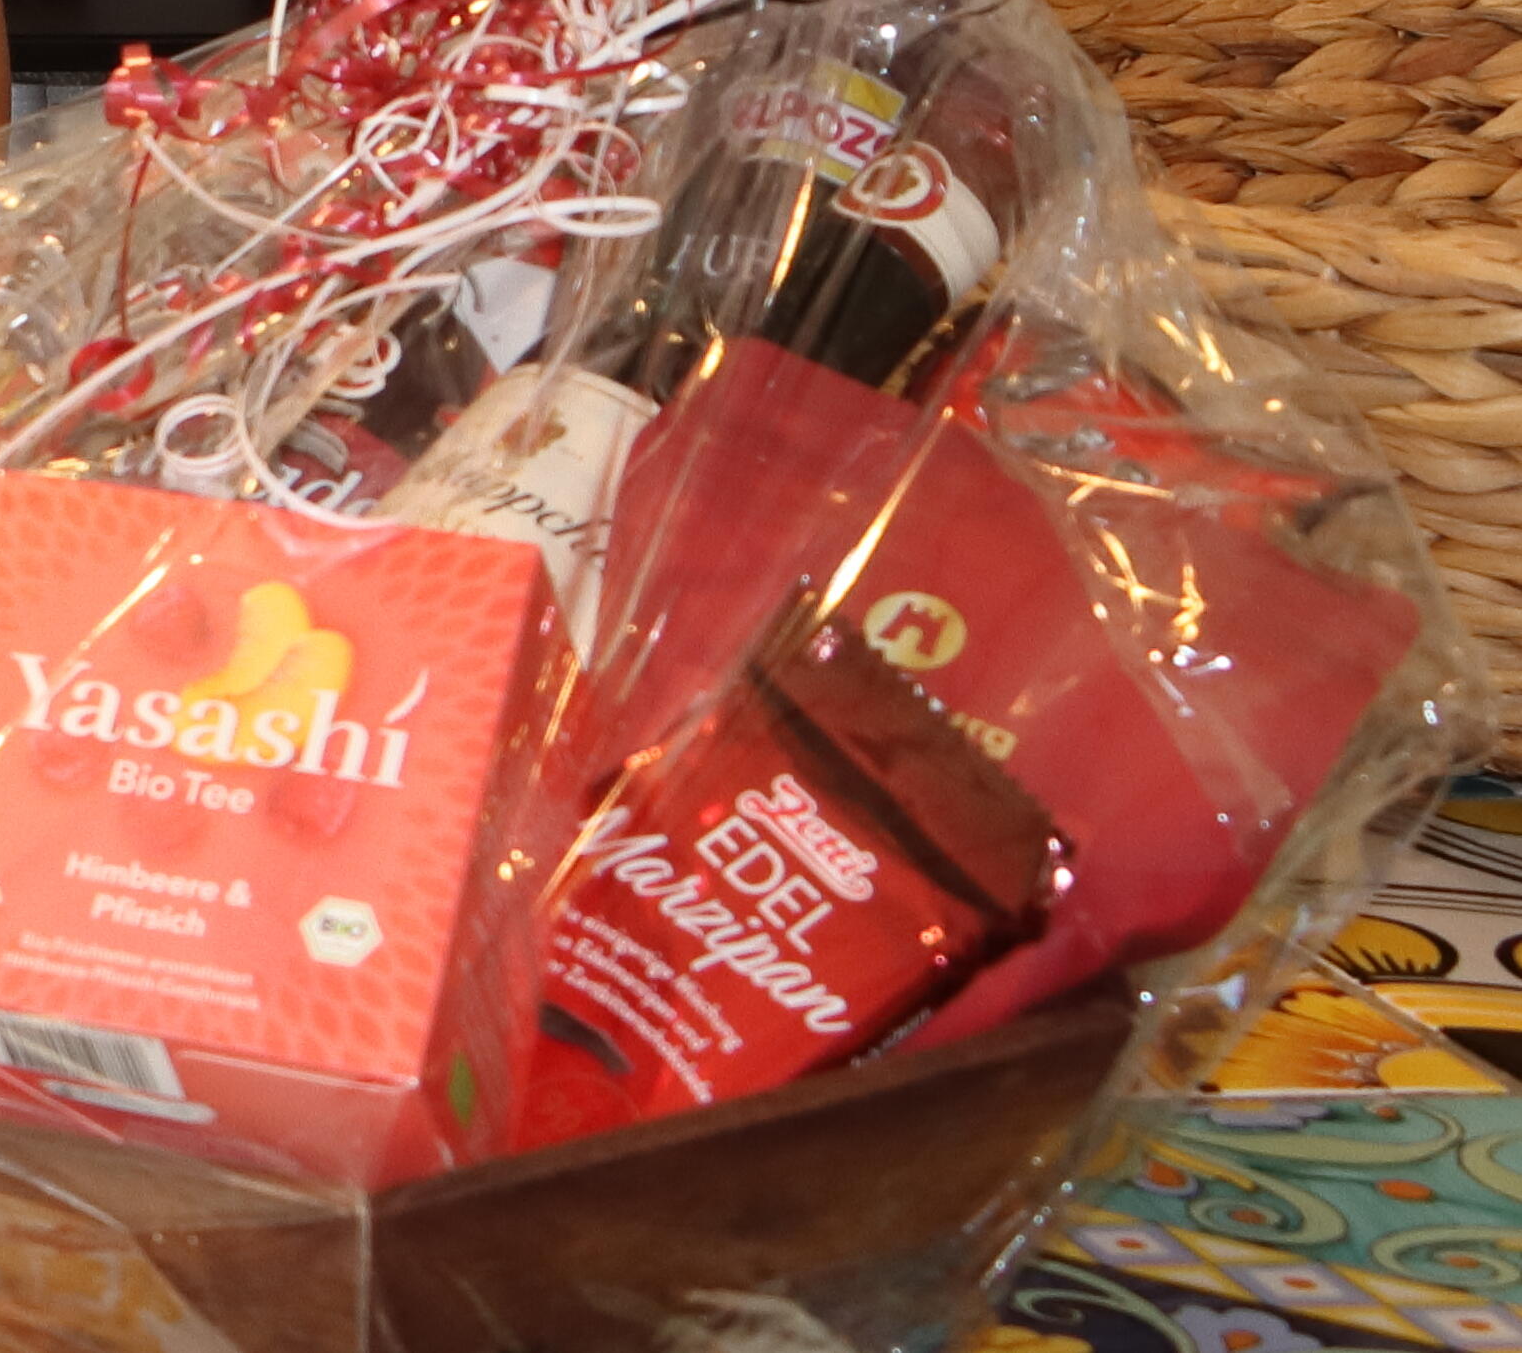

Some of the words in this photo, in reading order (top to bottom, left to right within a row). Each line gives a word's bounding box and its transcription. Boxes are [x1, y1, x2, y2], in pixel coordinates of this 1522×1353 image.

[107, 757, 177, 802] Bio
[183, 769, 256, 816] Tee
[64, 851, 220, 904] Himbeere
[223, 878, 253, 909] &
[695, 816, 834, 956] EDEL
[90, 892, 208, 939] Pfirsich
[578, 806, 853, 1033] Marzipan
